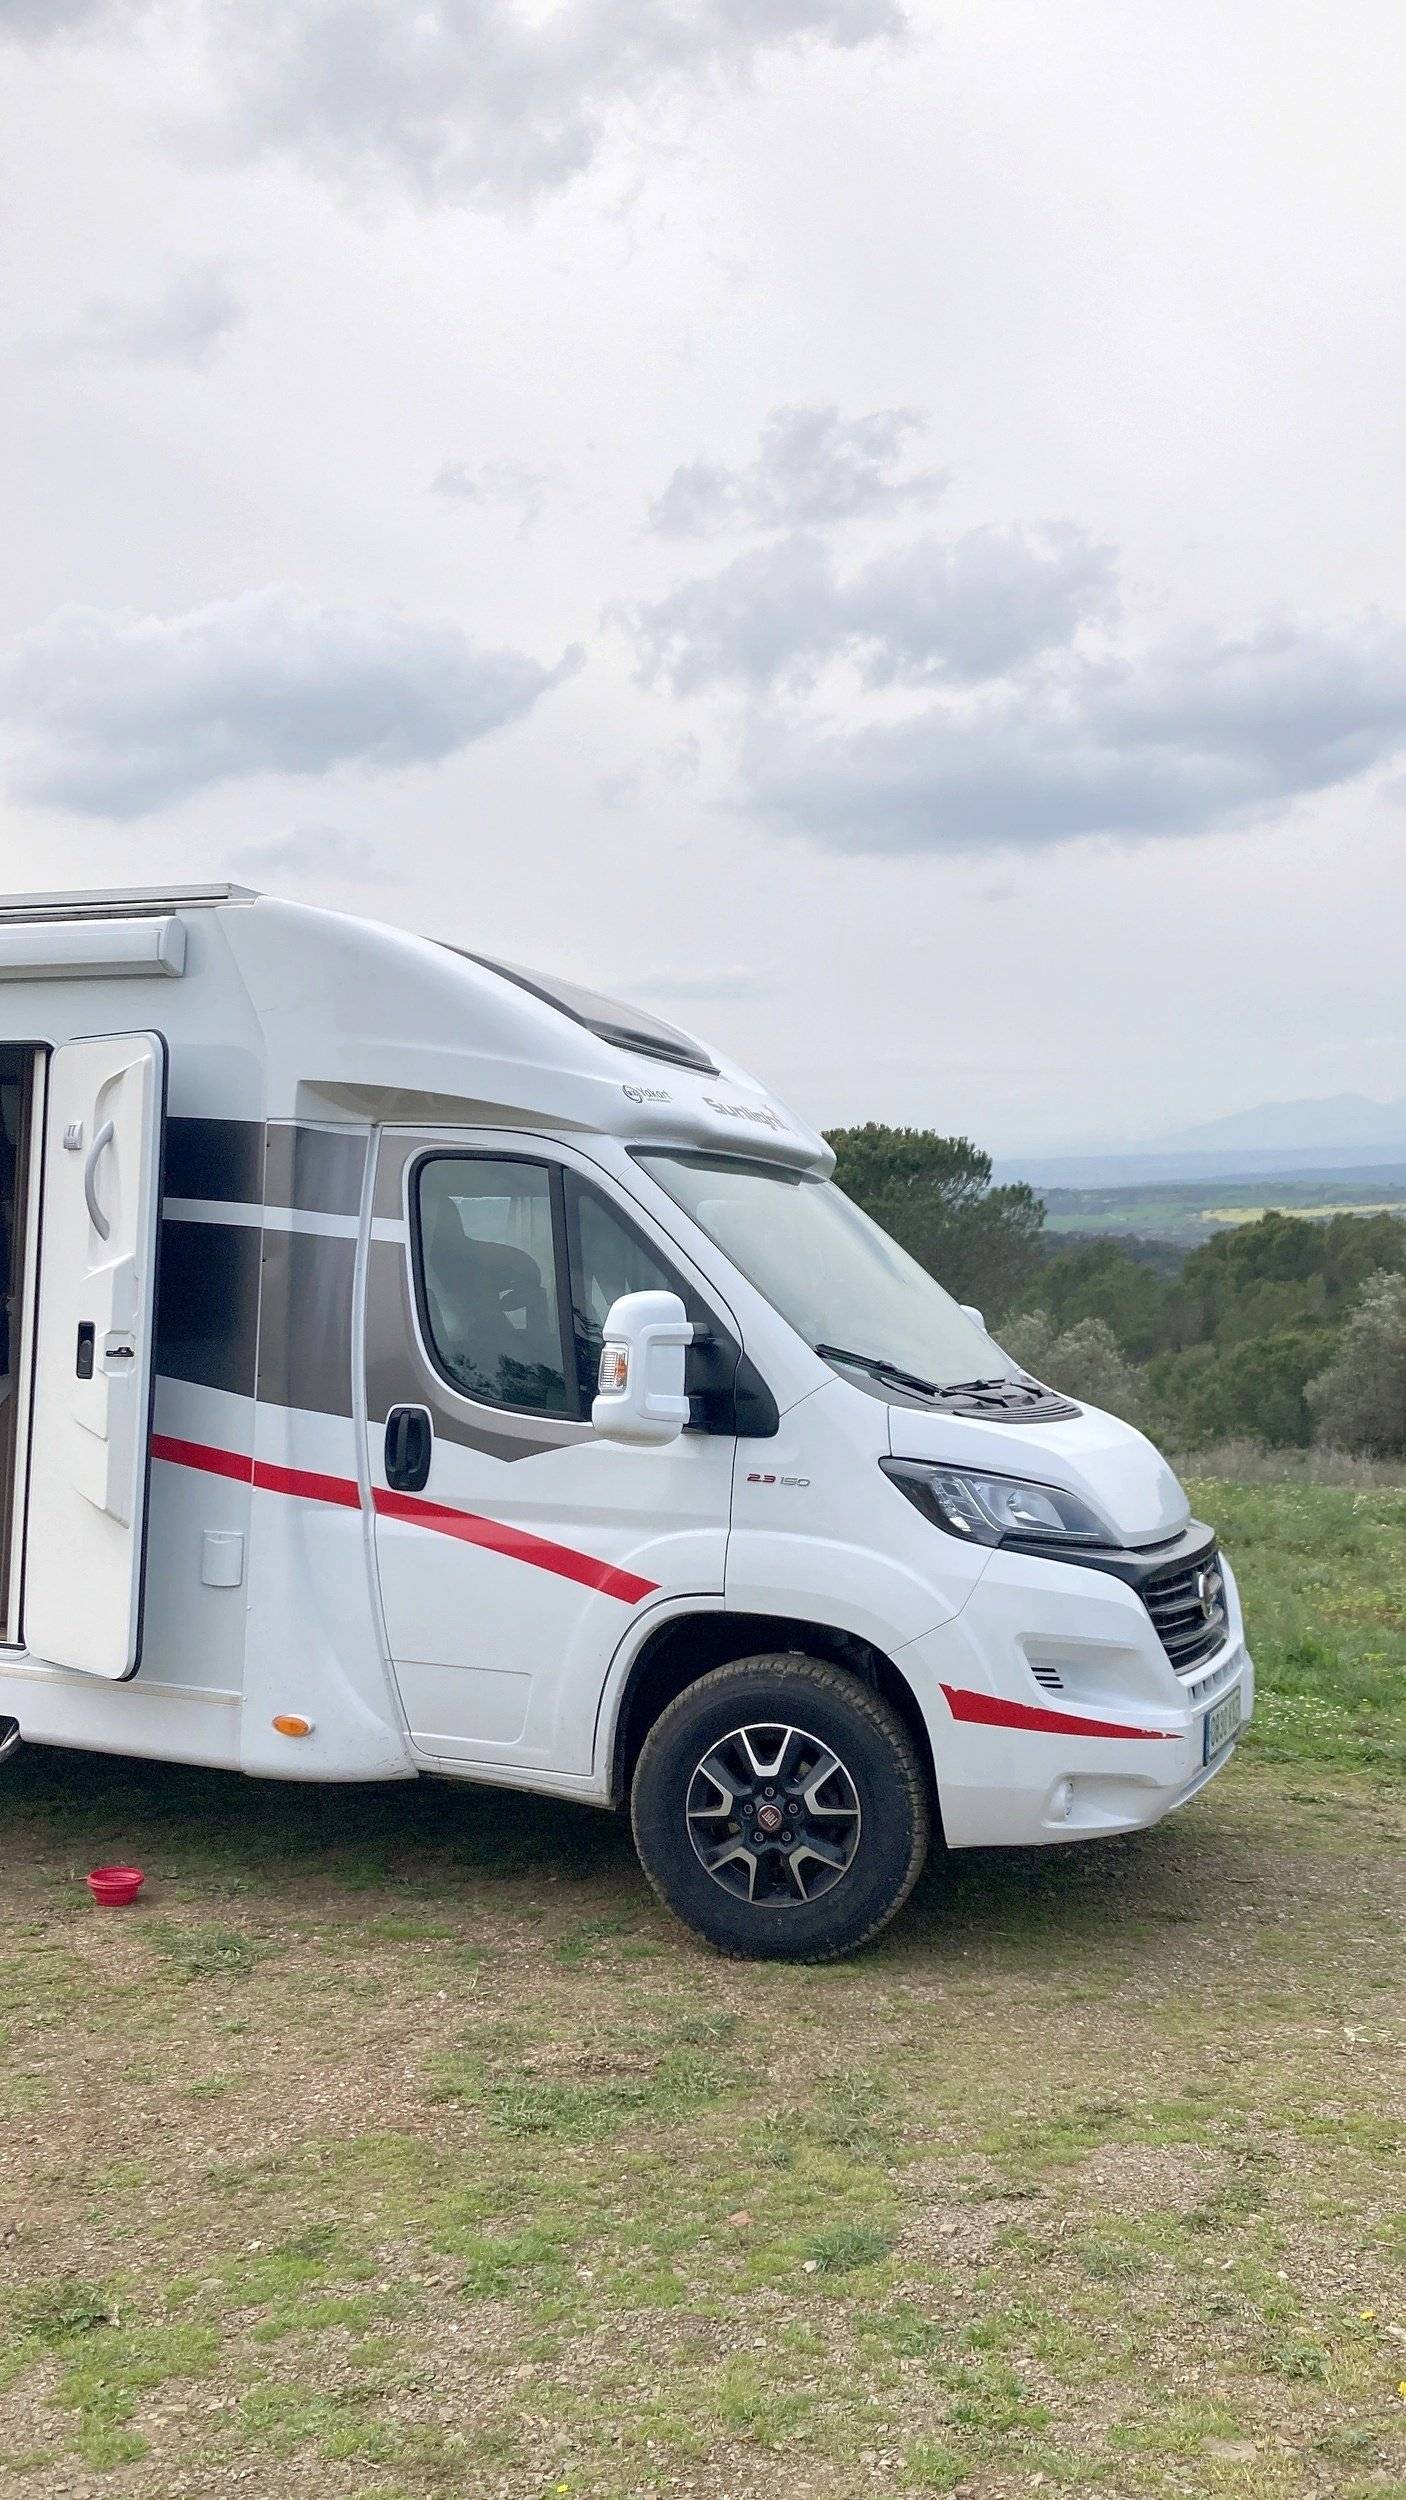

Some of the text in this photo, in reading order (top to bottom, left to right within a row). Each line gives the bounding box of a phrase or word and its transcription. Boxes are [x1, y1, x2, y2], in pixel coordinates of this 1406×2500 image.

[702, 1097, 790, 1131] Sunlight
[780, 1476, 811, 1487] 150
[761, 1809, 779, 1827] FIAT
